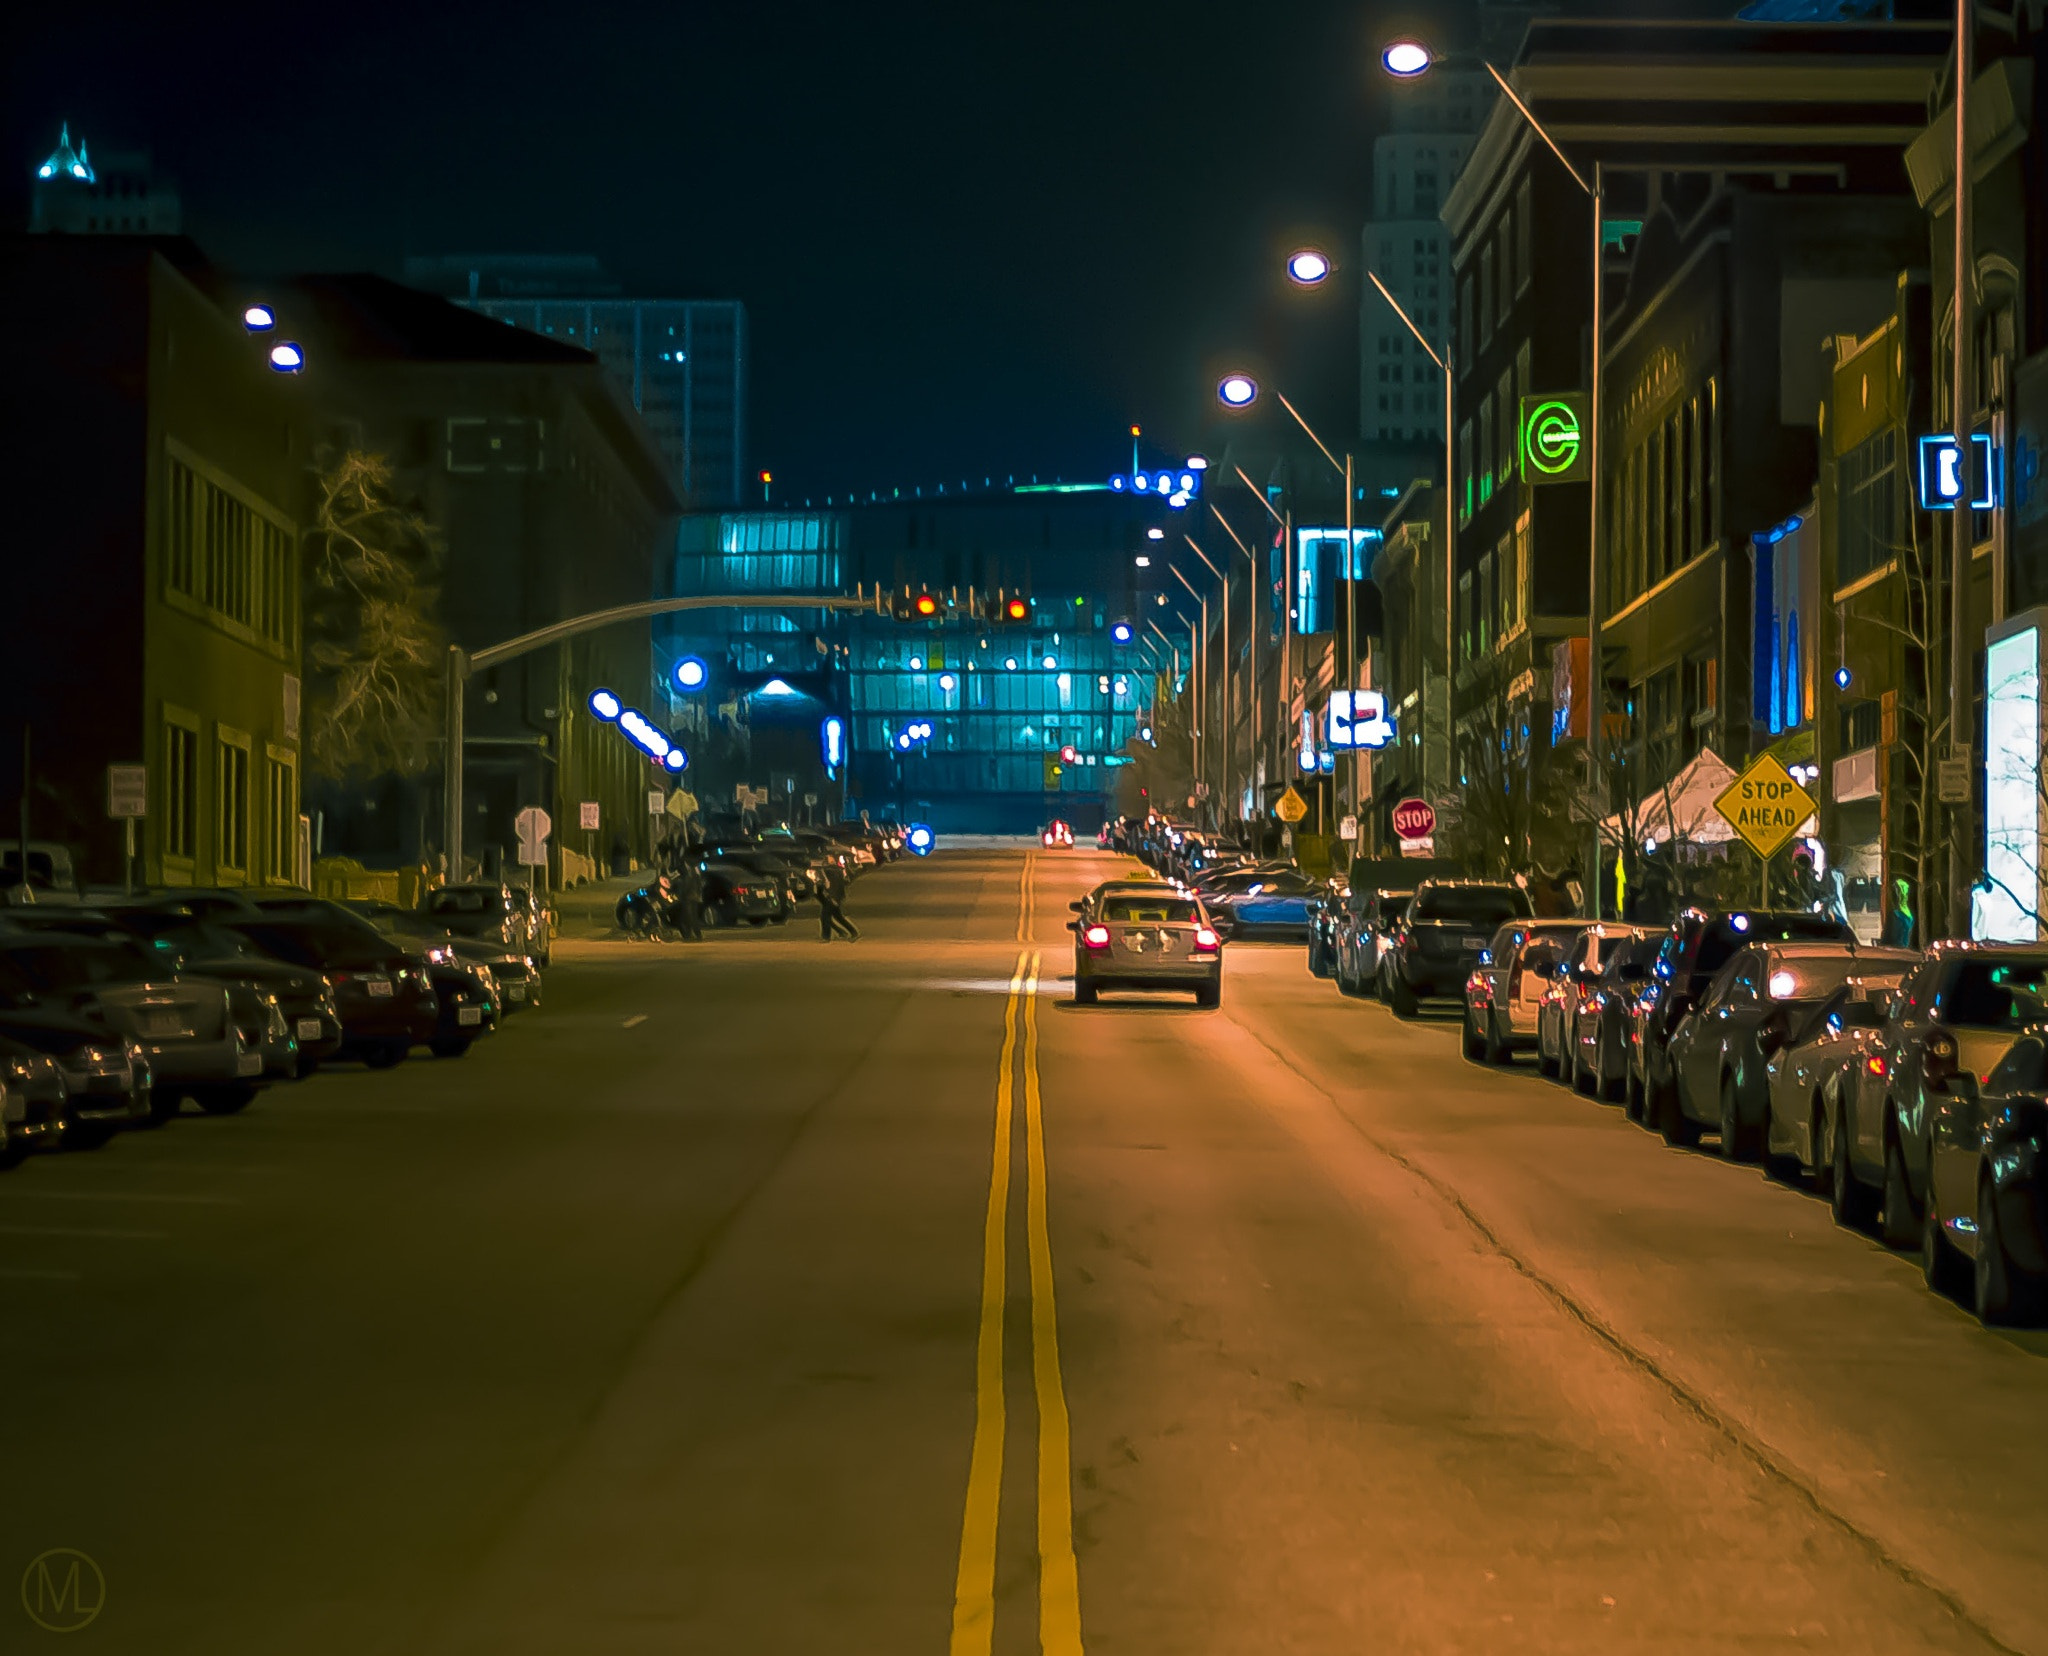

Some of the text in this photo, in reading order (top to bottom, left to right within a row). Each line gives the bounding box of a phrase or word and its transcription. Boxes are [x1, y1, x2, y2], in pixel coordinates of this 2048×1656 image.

[1741, 781, 1793, 800] STOP
[1396, 809, 1432, 830] STOP
[1738, 806, 1796, 827] AHEAD
